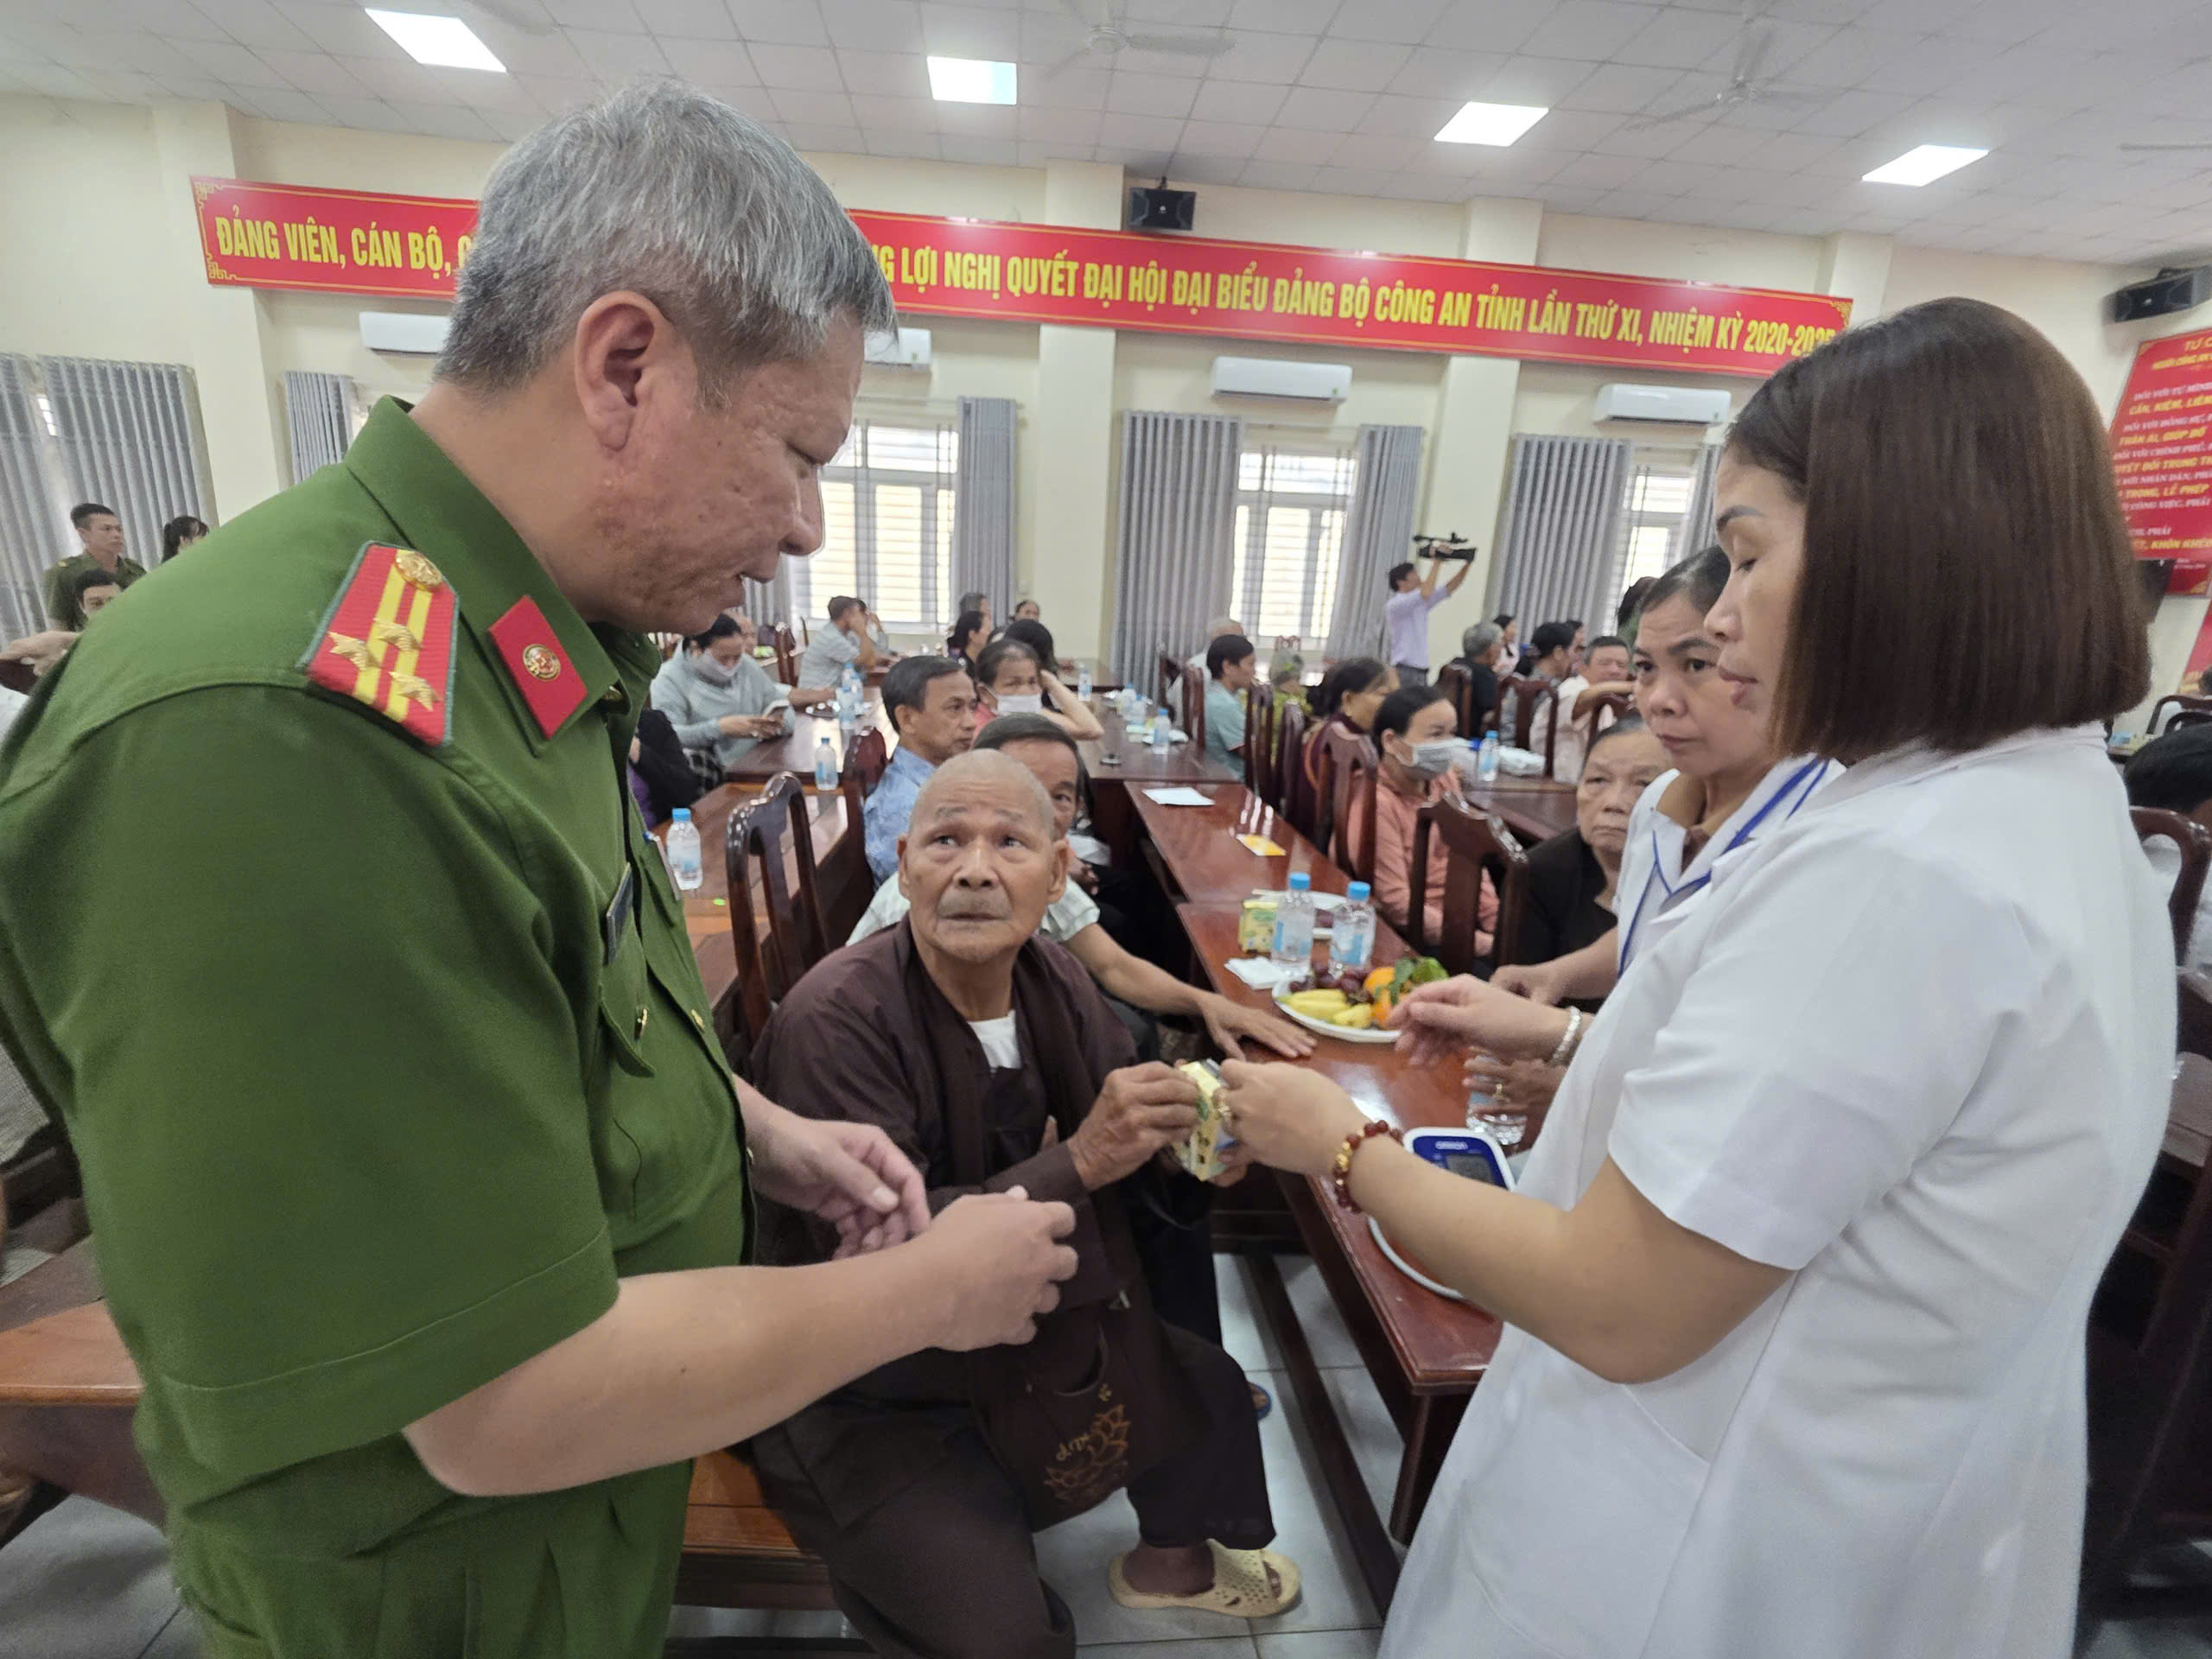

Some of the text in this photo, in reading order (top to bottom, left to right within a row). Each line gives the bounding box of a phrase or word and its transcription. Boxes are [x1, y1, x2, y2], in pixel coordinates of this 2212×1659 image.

[215, 205, 280, 259] ĐẢNG
[283, 216, 346, 269] VIÊN,
[351, 221, 403, 269] CÁN
[408, 226, 451, 279] BỘ,
[901, 245, 938, 294] LỢI
[944, 251, 1001, 299] NGHỊ
[1007, 249, 1079, 297] QUYẾT
[1084, 262, 1122, 308] ĐẠI
[1128, 259, 1167, 311] HỘI
[1172, 270, 1211, 315] ĐẠI
[1216, 260, 1269, 312] BIỂU
[1273, 267, 1335, 317] ĐẢNG
[1338, 276, 1370, 328] BỘ
[1375, 279, 1435, 325] CÔNG
[1438, 290, 1472, 327] AN
[1476, 283, 1526, 332] TỈNH
[1575, 298, 1619, 340] THỨ
[1617, 307, 1643, 346] XI,
[1649, 307, 1715, 353] NHIỆM
[1715, 311, 1744, 352] KỲ
